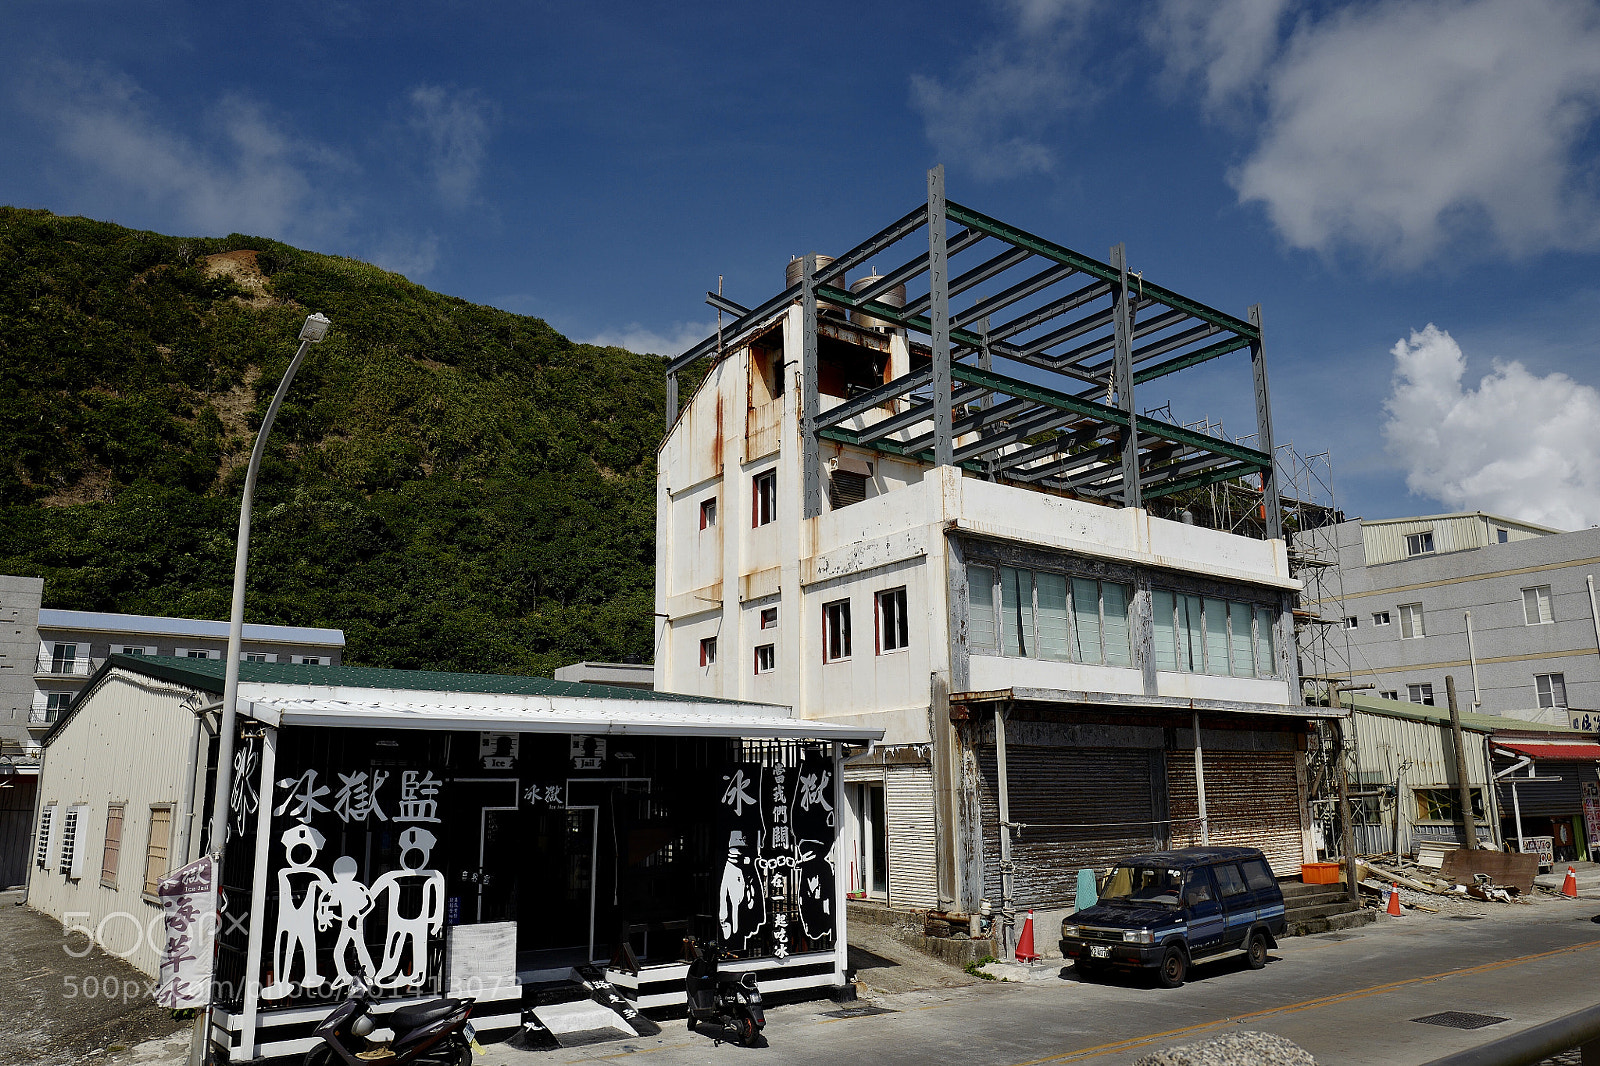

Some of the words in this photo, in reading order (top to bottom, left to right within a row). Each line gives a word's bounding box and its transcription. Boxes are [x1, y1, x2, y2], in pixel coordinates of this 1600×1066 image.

[491, 758, 506, 768] Ice
[580, 759, 596, 770] Jail
[523, 783, 564, 805] 冰獄
